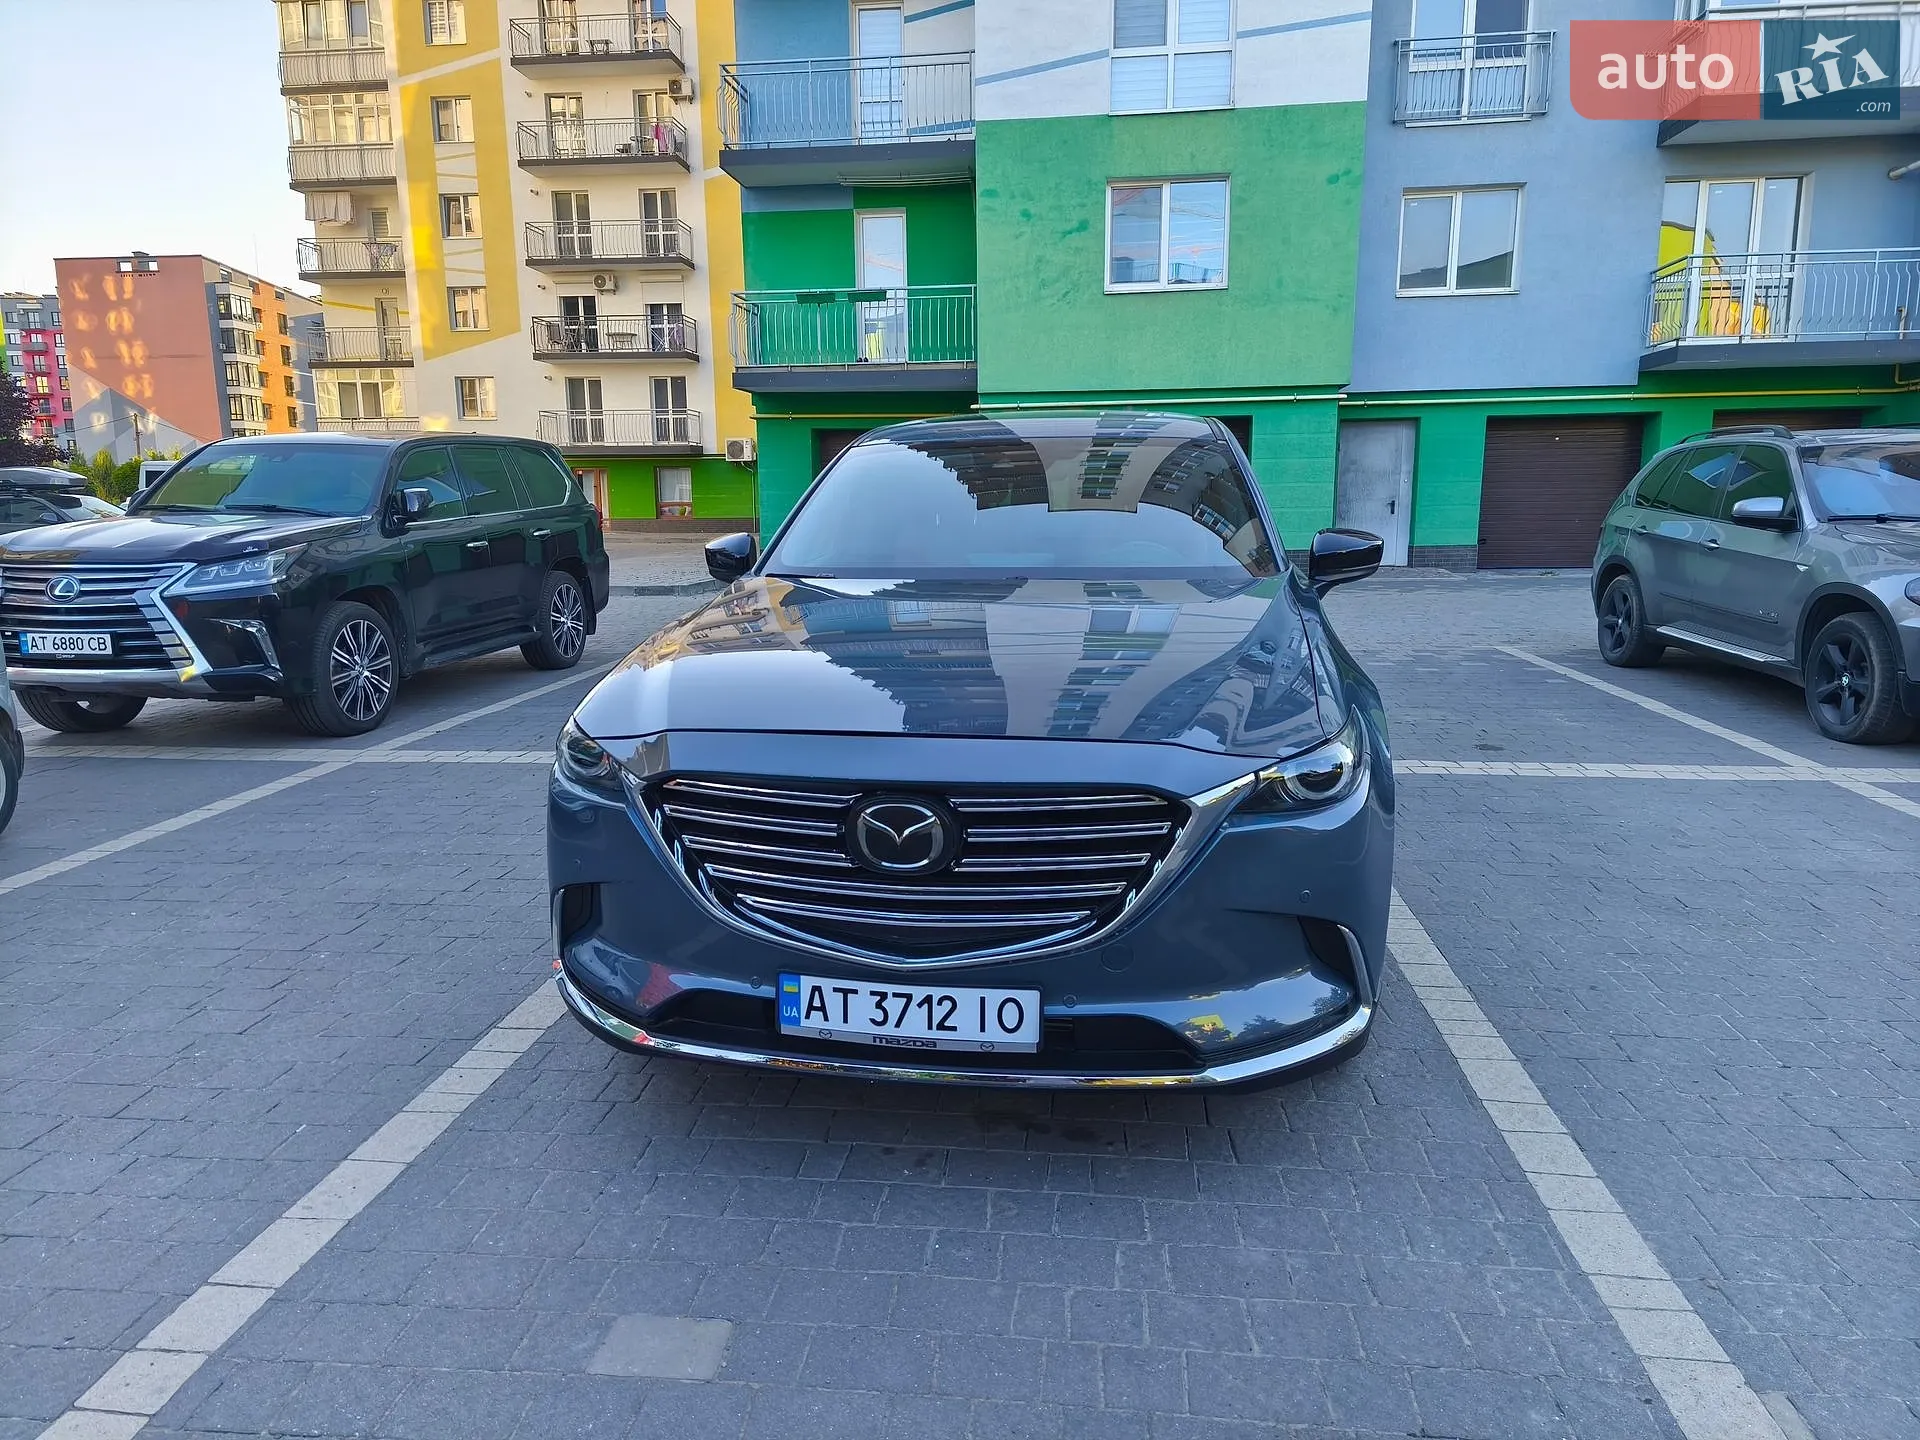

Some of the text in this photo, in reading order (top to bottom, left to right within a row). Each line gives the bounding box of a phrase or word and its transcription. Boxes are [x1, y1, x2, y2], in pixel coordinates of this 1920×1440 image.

[30, 636, 47, 651] AT
[52, 636, 84, 651] 6880
[87, 637, 107, 651] CB
[783, 1005, 799, 1018] UA
[804, 985, 1025, 1034] AT 3712 IO
